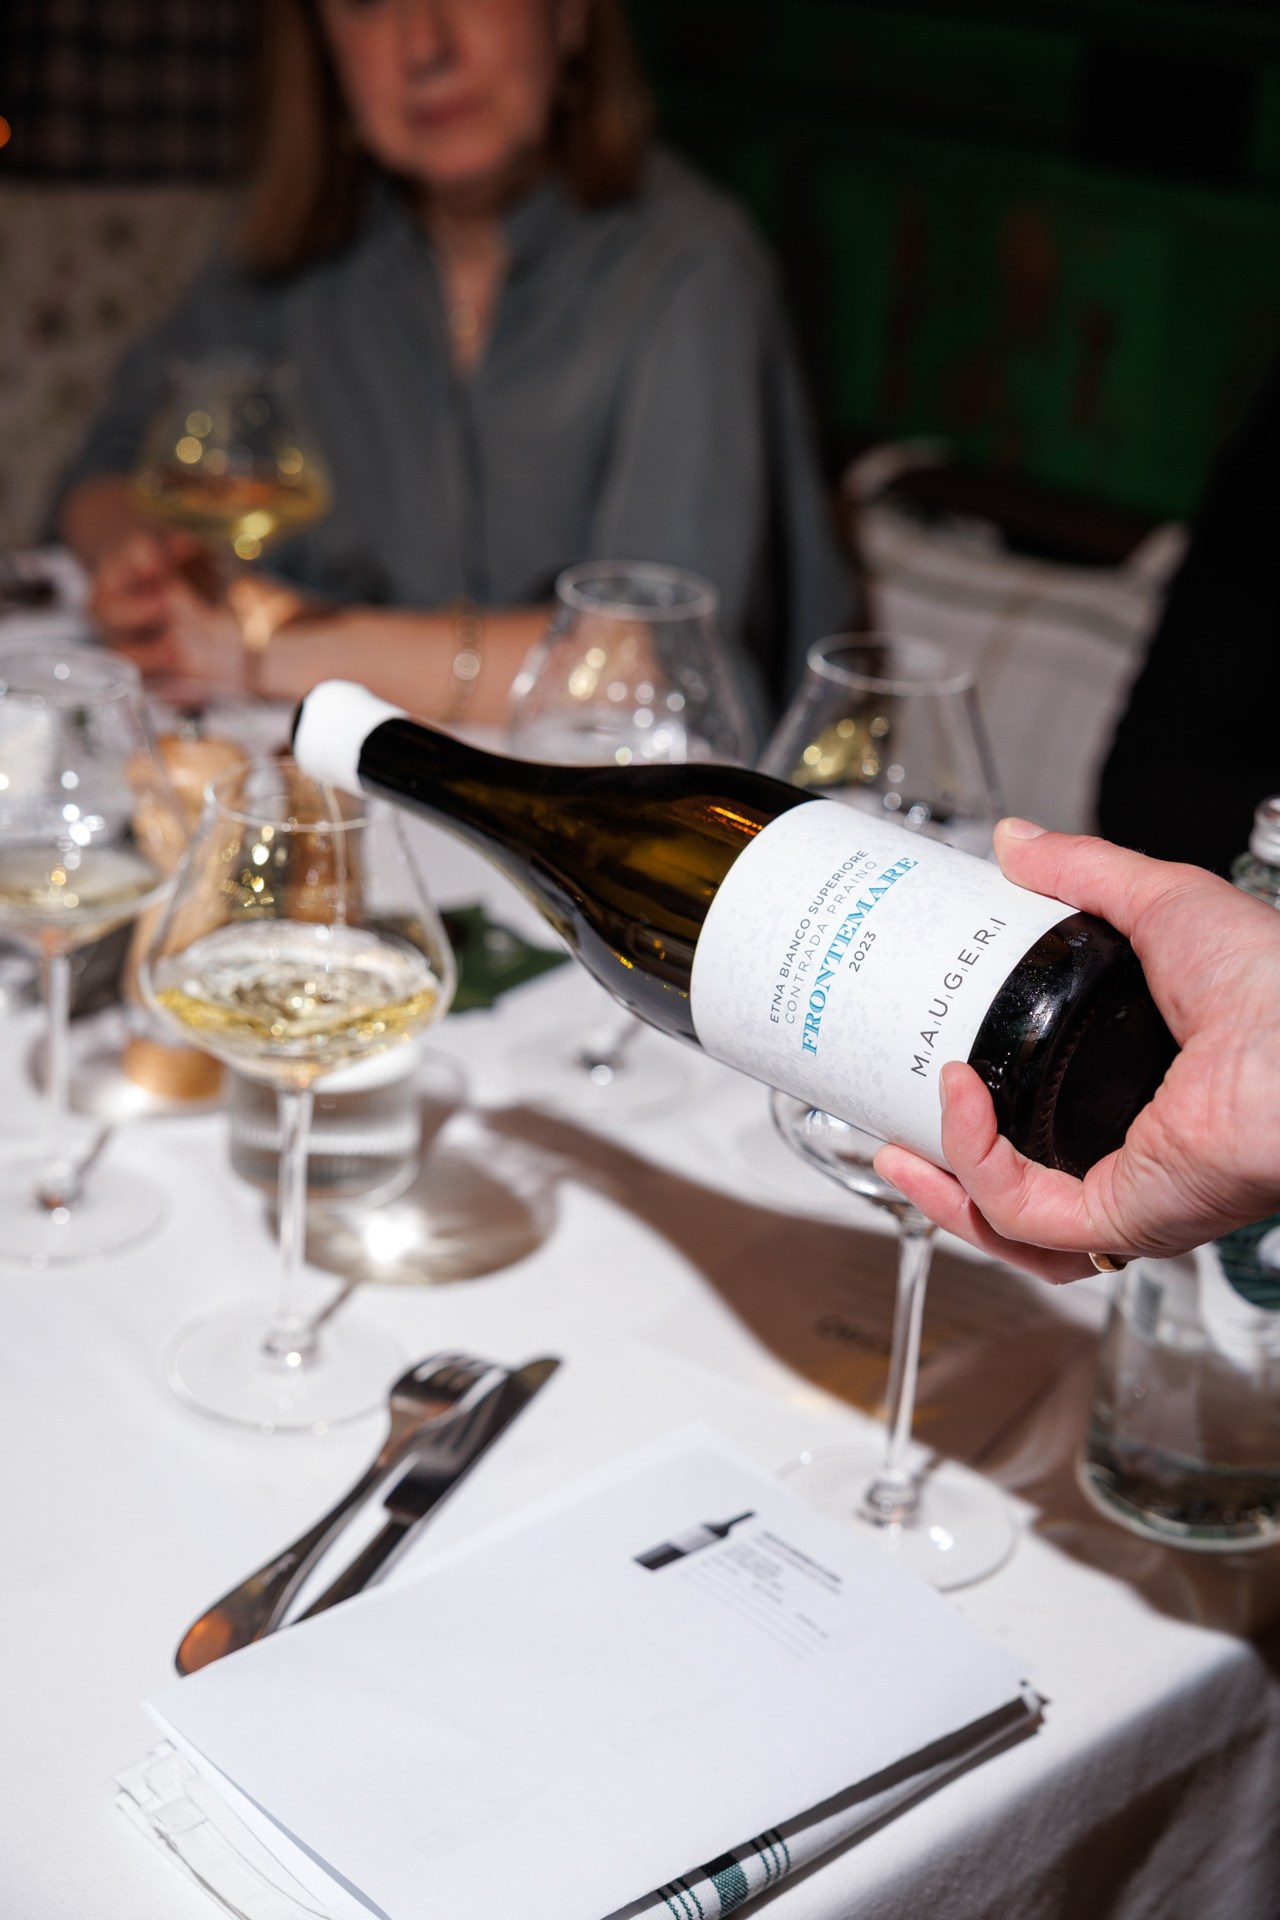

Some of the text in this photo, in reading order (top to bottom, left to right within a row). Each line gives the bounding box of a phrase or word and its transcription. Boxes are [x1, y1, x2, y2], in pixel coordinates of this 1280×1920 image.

[769, 849, 869, 1024] ETNA BIANCO SUPERIORE
[785, 860, 877, 1025] CONTRADA PRAINO
[801, 856, 920, 1057] FRONTEMARE
[848, 931, 877, 973] 2023
